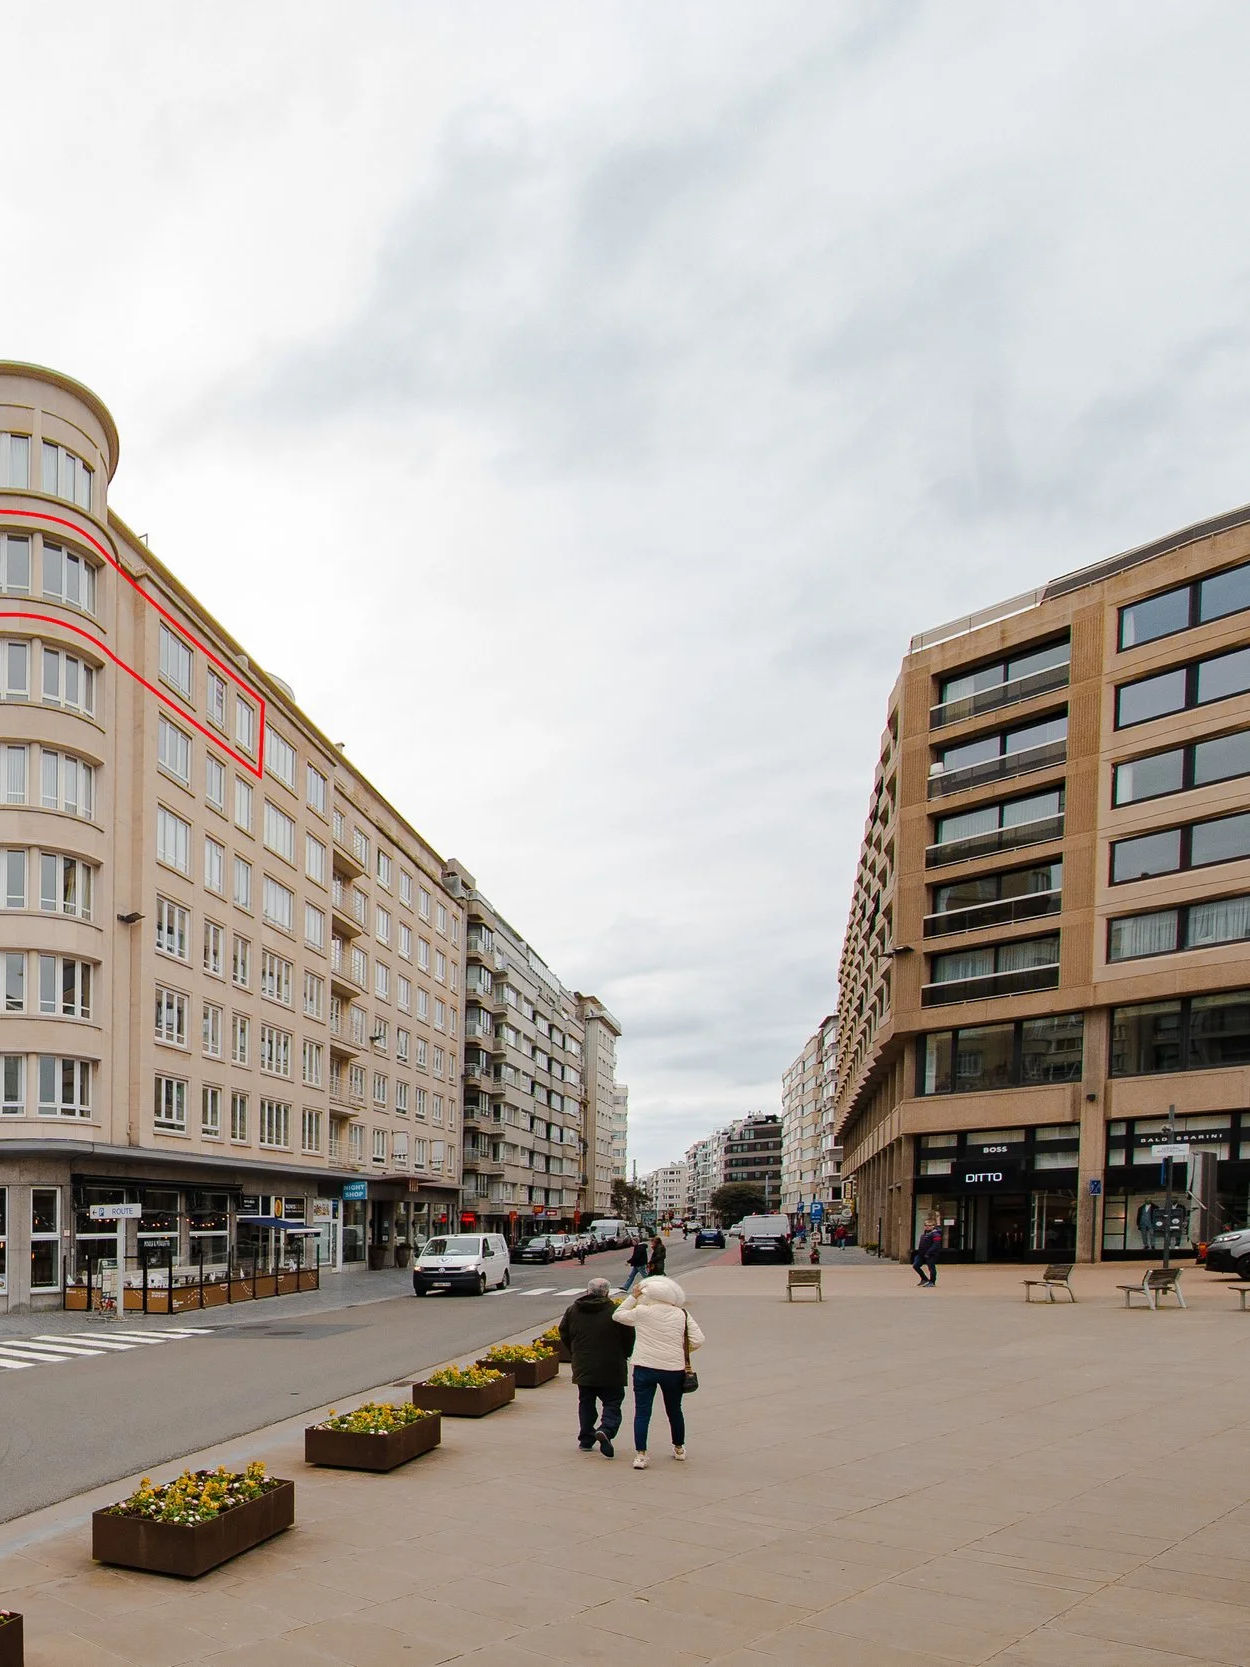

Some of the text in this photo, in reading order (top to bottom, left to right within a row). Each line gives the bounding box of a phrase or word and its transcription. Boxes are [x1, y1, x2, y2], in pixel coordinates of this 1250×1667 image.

[1140, 1133, 1223, 1143] BALDSSARINI
[965, 1172, 1003, 1183] DITTO
[112, 1207, 134, 1215] ROUTE
[812, 1204, 821, 1214] P
